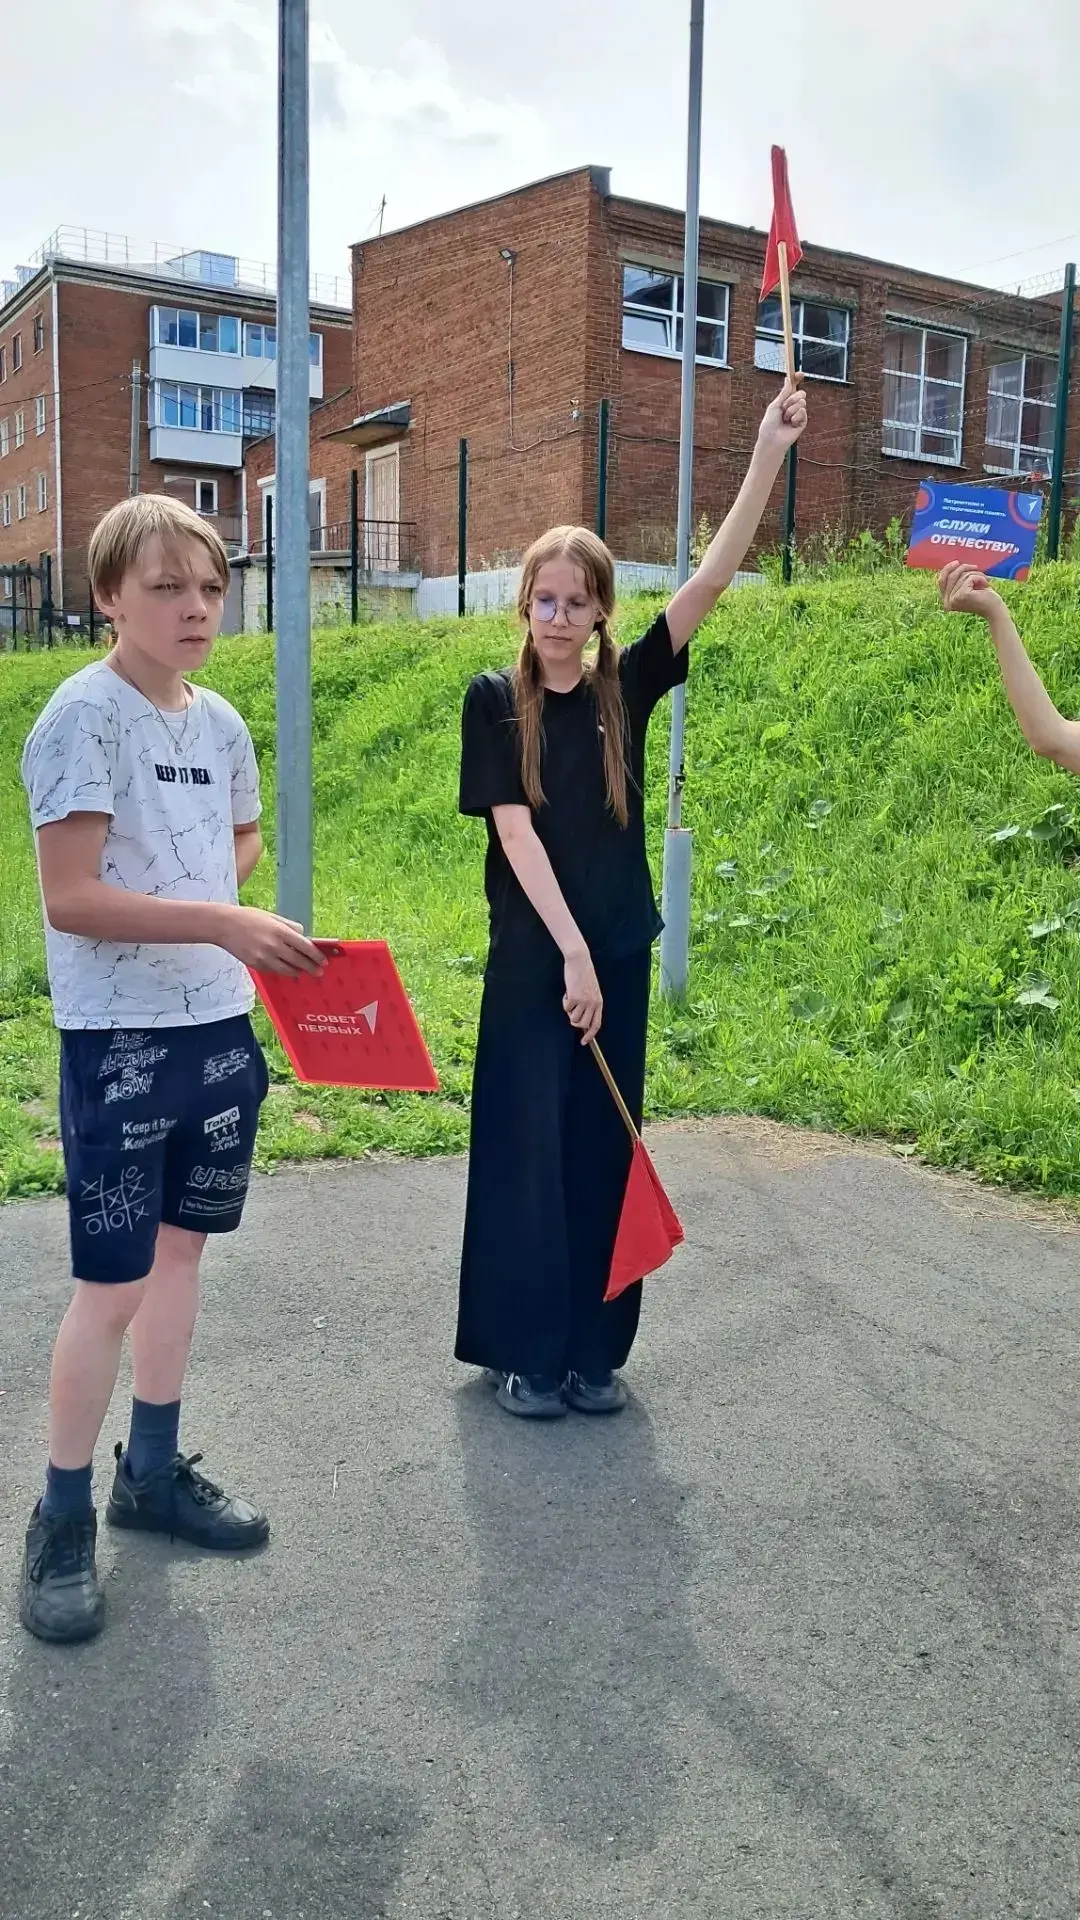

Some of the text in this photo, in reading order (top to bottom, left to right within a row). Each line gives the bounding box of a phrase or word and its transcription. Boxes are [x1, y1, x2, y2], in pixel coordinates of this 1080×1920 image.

[933, 519, 991, 534] «СЛУЖИ
[930, 534, 1020, 554] ОТЕЧЕСТВУ!»
[154, 763, 177, 783] KEEP
[178, 767, 189, 784] IT
[306, 1013, 357, 1024] СОВЕТ
[297, 1023, 363, 1035] ПЕРВЫХ
[122, 1120, 150, 1135] Keep
[205, 1109, 238, 1131] Tokyo
